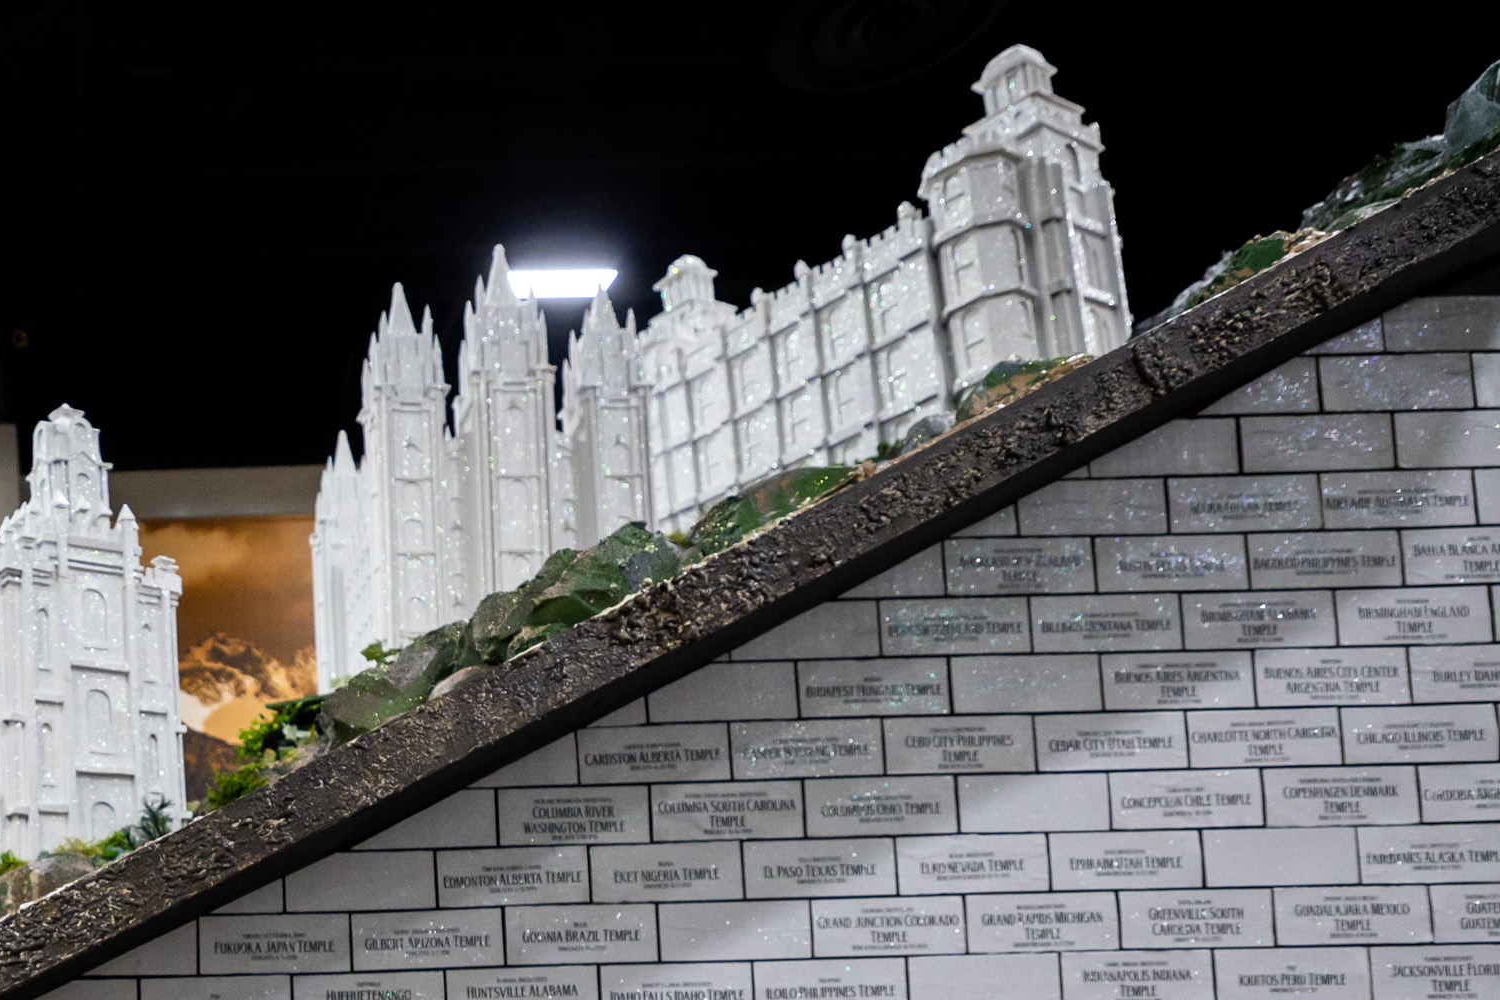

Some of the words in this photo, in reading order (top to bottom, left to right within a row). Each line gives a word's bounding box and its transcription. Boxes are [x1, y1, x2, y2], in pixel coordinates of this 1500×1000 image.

[1446, 728, 1486, 742] TEMPLE
[583, 752, 638, 766] CARDSTON
[638, 750, 682, 764] ALBERTA
[683, 748, 720, 762] TEMPLE
[531, 806, 584, 819] COLUMBIA
[584, 805, 615, 818] RIVER
[522, 821, 587, 835] WASHINGTON
[588, 819, 626, 833] TEMPLE
[442, 874, 498, 888] EDMONTON
[498, 872, 543, 886] ALBERTA
[544, 870, 583, 884] TEMPLE
[640, 869, 680, 883] NIGERIA
[681, 867, 720, 881] TEMPLE
[265, 940, 297, 954] JAPAN
[298, 939, 336, 954] TEMPLE
[407, 936, 451, 949] ARIZONA
[452, 934, 491, 948] TEMPLE
[465, 985, 526, 999] HUNTSVILLE
[528, 984, 579, 998] ALABAMA
[797, 985, 857, 999] PHILIPPINES
[858, 984, 896, 998] TEMPLE
